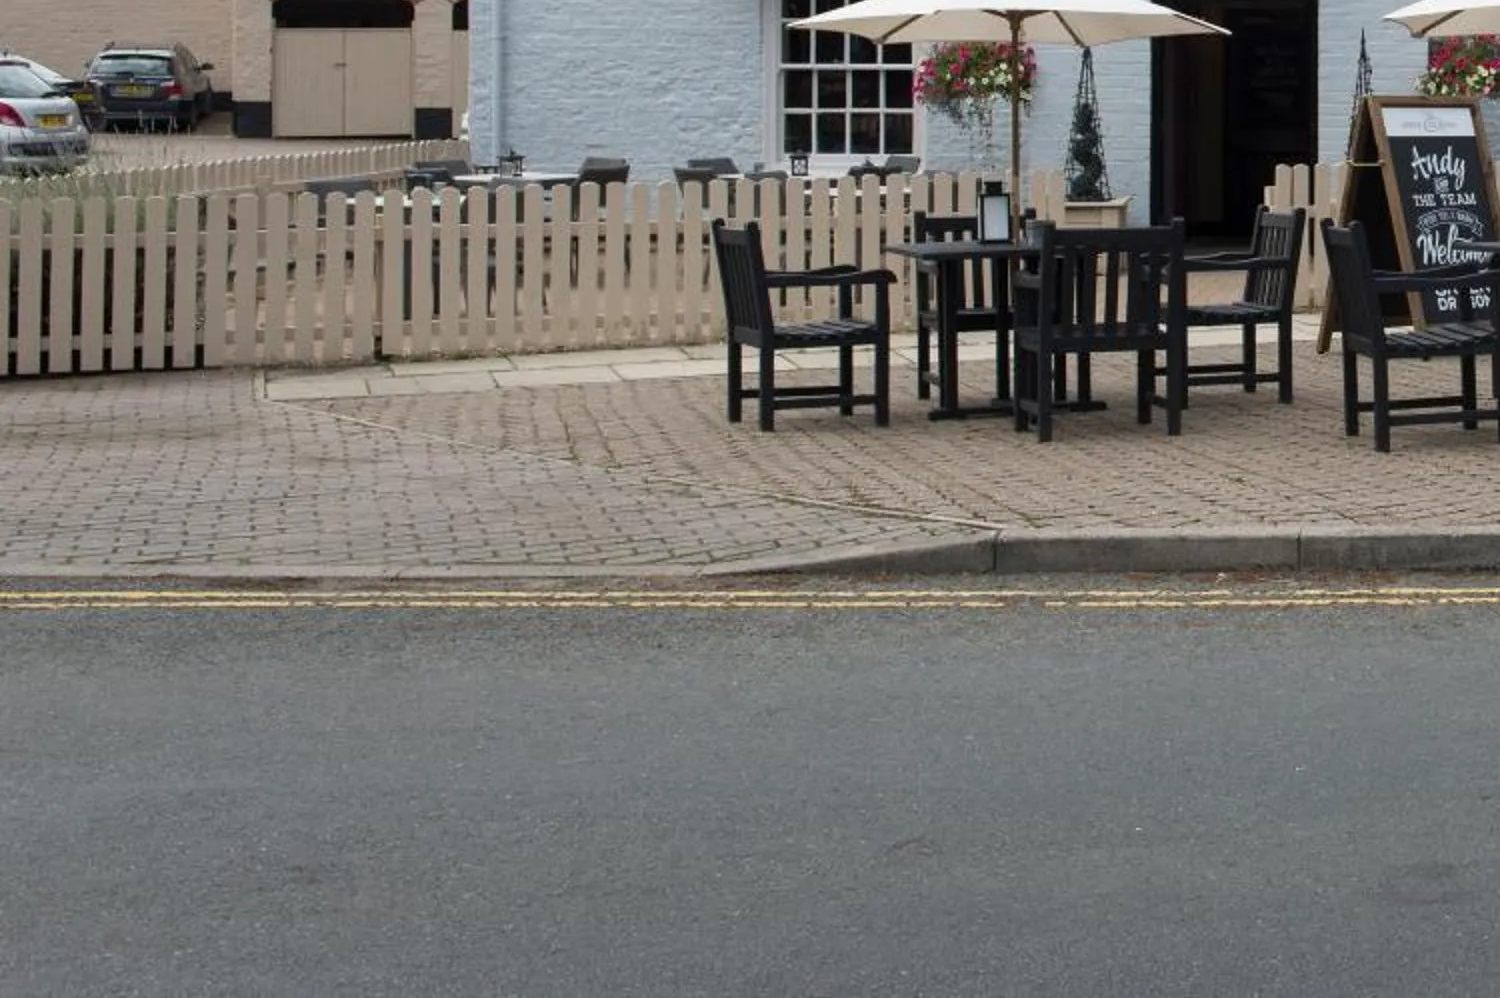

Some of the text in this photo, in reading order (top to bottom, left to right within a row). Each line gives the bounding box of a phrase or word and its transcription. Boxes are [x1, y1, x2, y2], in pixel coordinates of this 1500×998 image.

[1411, 145, 1465, 191] Andy
[1412, 192, 1477, 207] THE TEAM
